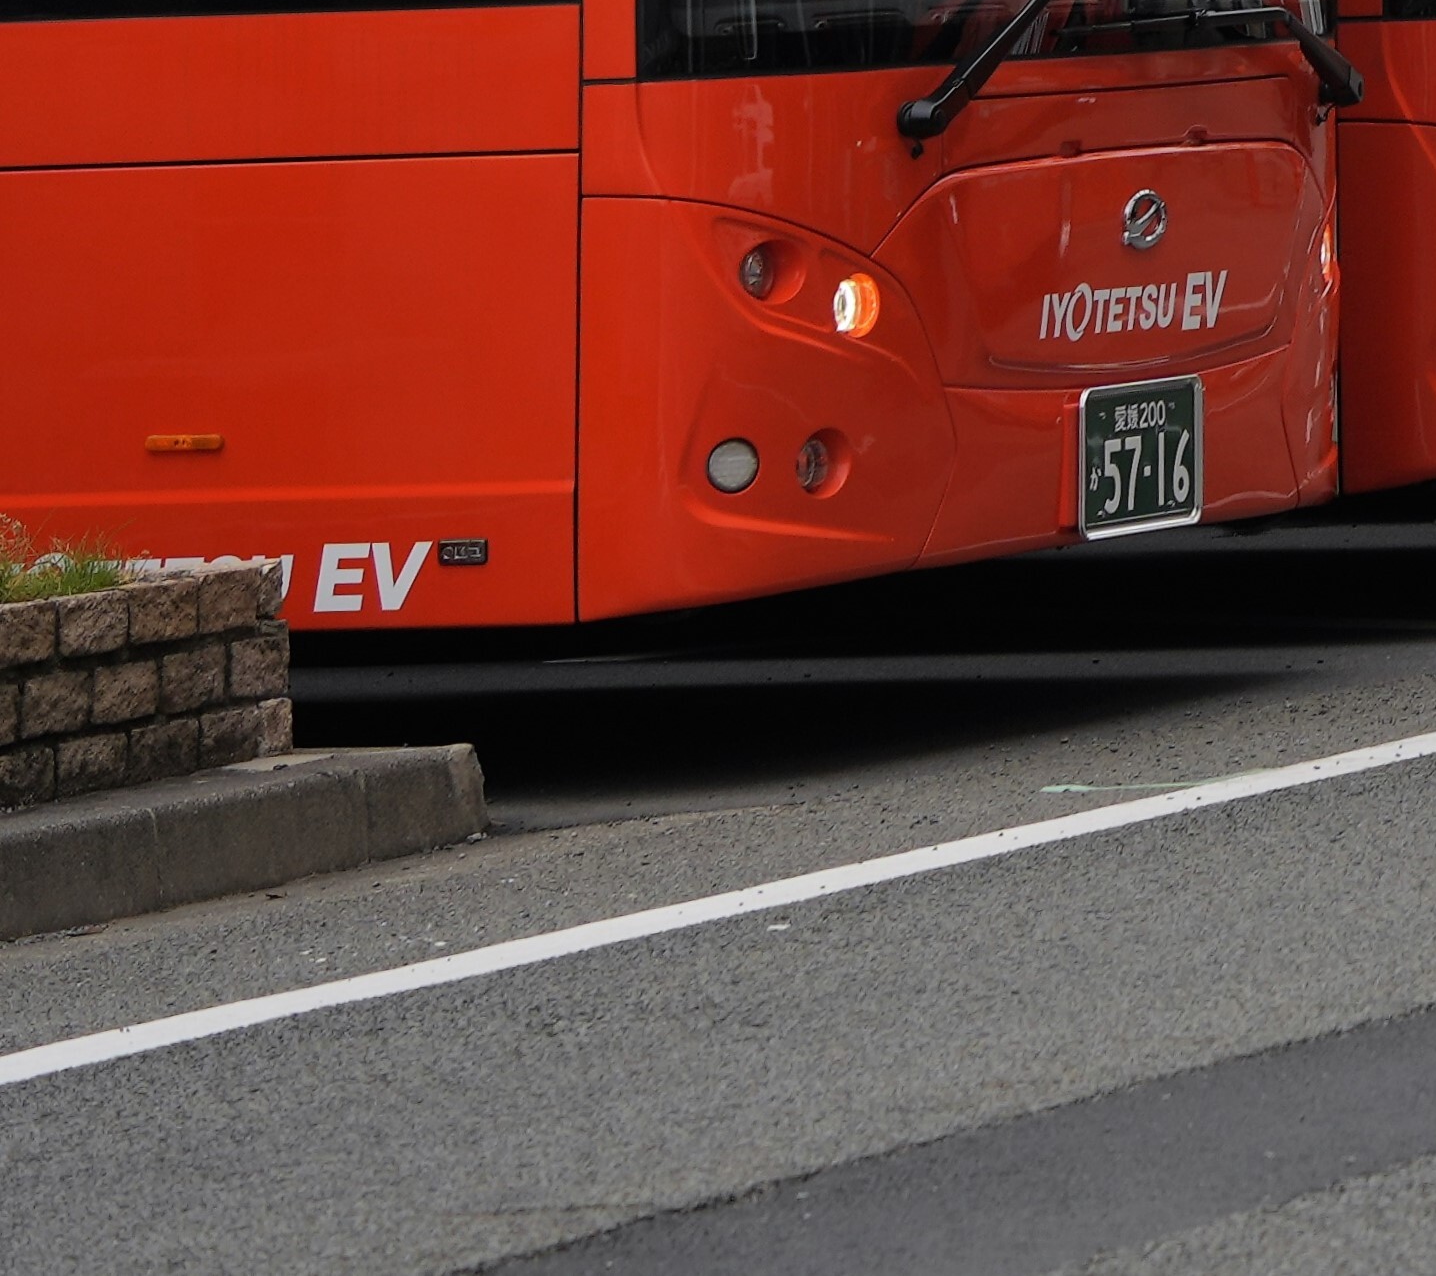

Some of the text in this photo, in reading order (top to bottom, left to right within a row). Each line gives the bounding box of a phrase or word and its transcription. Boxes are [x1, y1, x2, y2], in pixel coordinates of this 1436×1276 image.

[1039, 269, 1228, 342] IYOTETSU EV
[1089, 427, 1190, 515] か 57-16
[313, 541, 434, 613] EV
